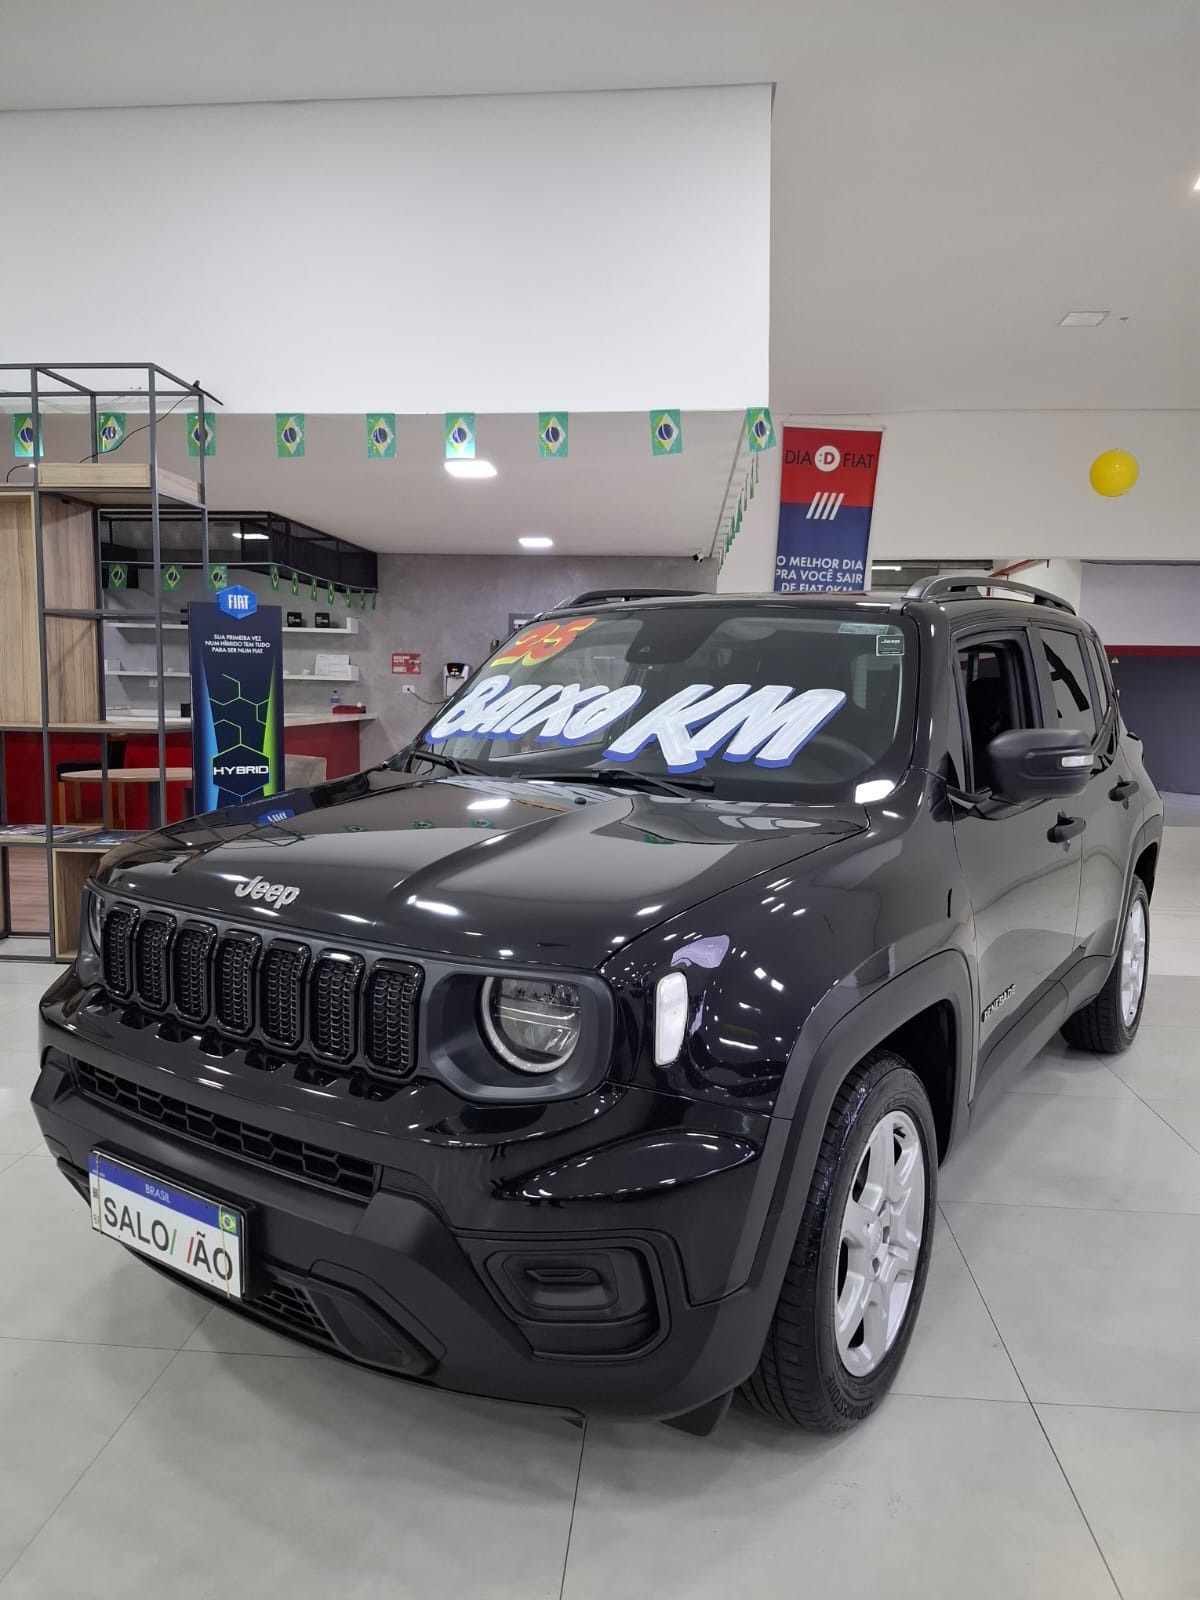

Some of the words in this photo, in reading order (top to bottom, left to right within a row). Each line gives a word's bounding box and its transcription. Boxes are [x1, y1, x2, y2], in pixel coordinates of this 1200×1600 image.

[785, 450, 812, 465] DIA
[843, 453, 875, 468] FIAT
[776, 555, 786, 566] O
[789, 556, 840, 570] MELHOR
[843, 559, 864, 571] DIA
[776, 568, 797, 580] PRA
[800, 569, 833, 582] VOCÊ
[836, 572, 863, 584] SAIR
[781, 582, 797, 592] DE
[800, 583, 824, 592] FIAT
[228, 594, 249, 610] FIAT
[425, 674, 646, 746] BAIXO
[602, 683, 847, 774] KM
[213, 765, 269, 775] HYBRID
[234, 875, 300, 909] Jeep
[144, 1183, 171, 1203] BRASIL
